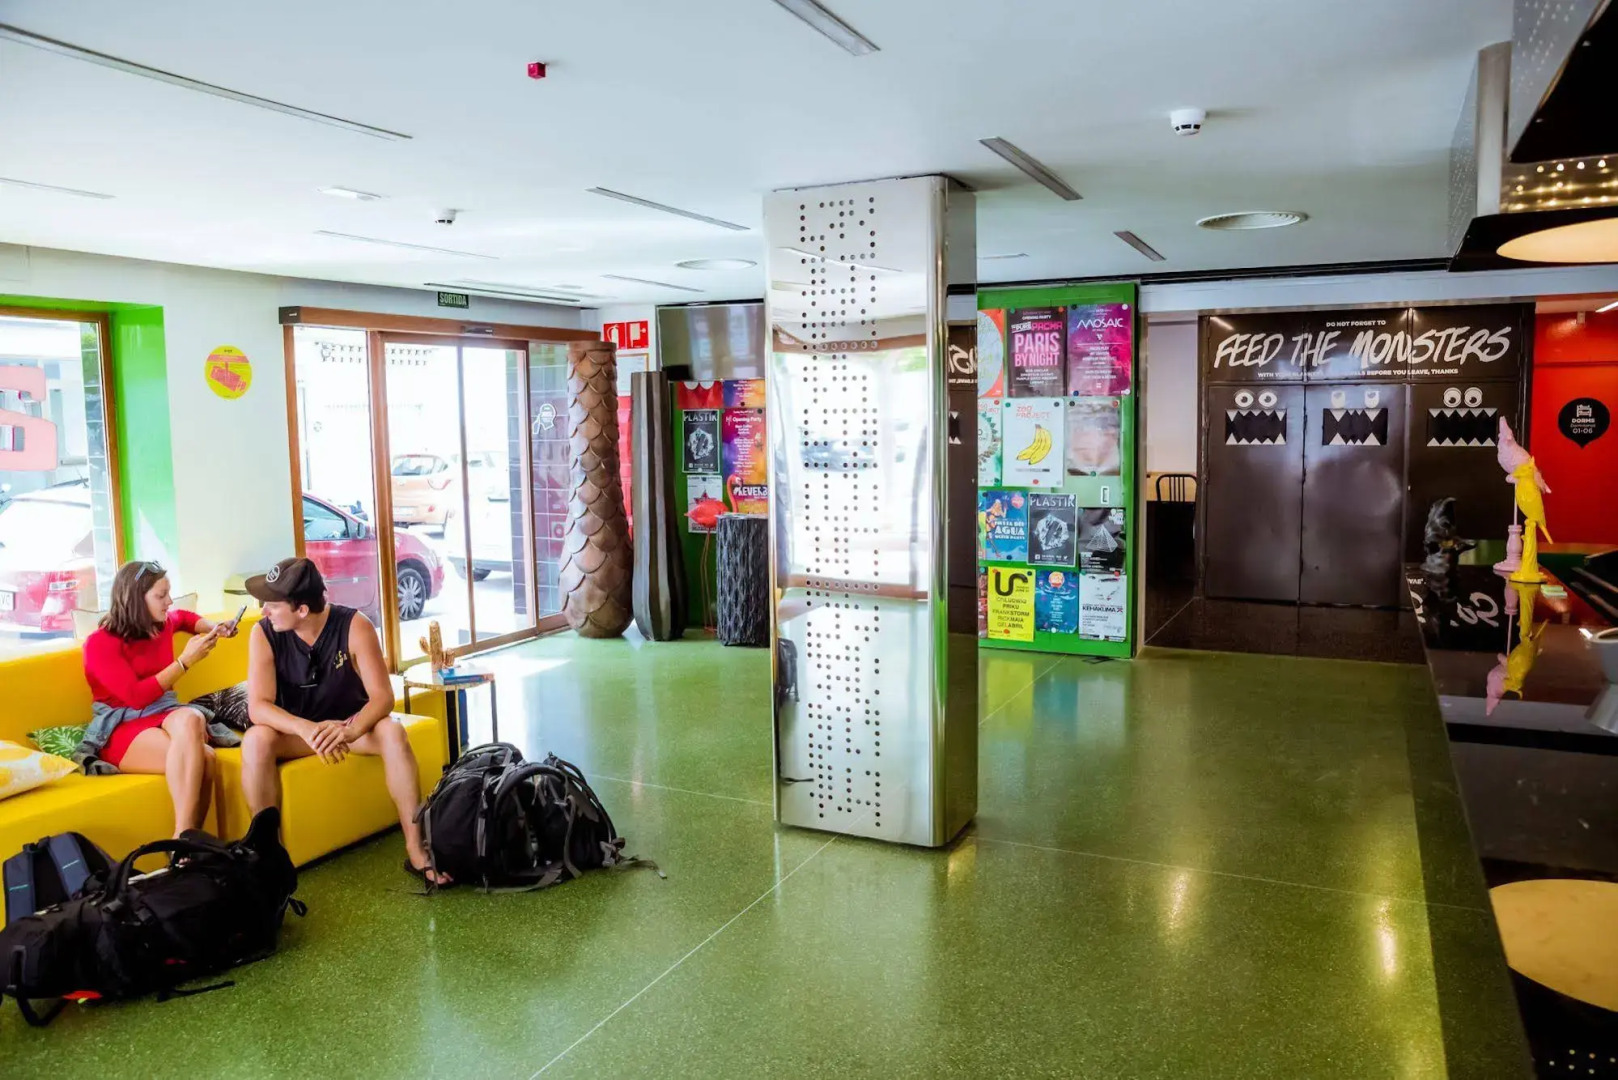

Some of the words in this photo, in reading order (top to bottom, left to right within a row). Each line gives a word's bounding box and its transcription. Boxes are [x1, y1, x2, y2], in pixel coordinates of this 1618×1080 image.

[439, 293, 467, 305] SORTIDA
[1076, 318, 1124, 329] MOSAIC
[1014, 332, 1060, 353] PARIS
[1213, 333, 1284, 369] FEED
[1290, 331, 1341, 367] THE
[1349, 326, 1512, 369] MONSTERS
[1014, 353, 1028, 367] BY
[1028, 352, 1060, 366] NIGHT
[684, 411, 718, 422] PLASTIK
[1030, 496, 1075, 508] PLASTIK
[994, 525, 1025, 536] AGUA
